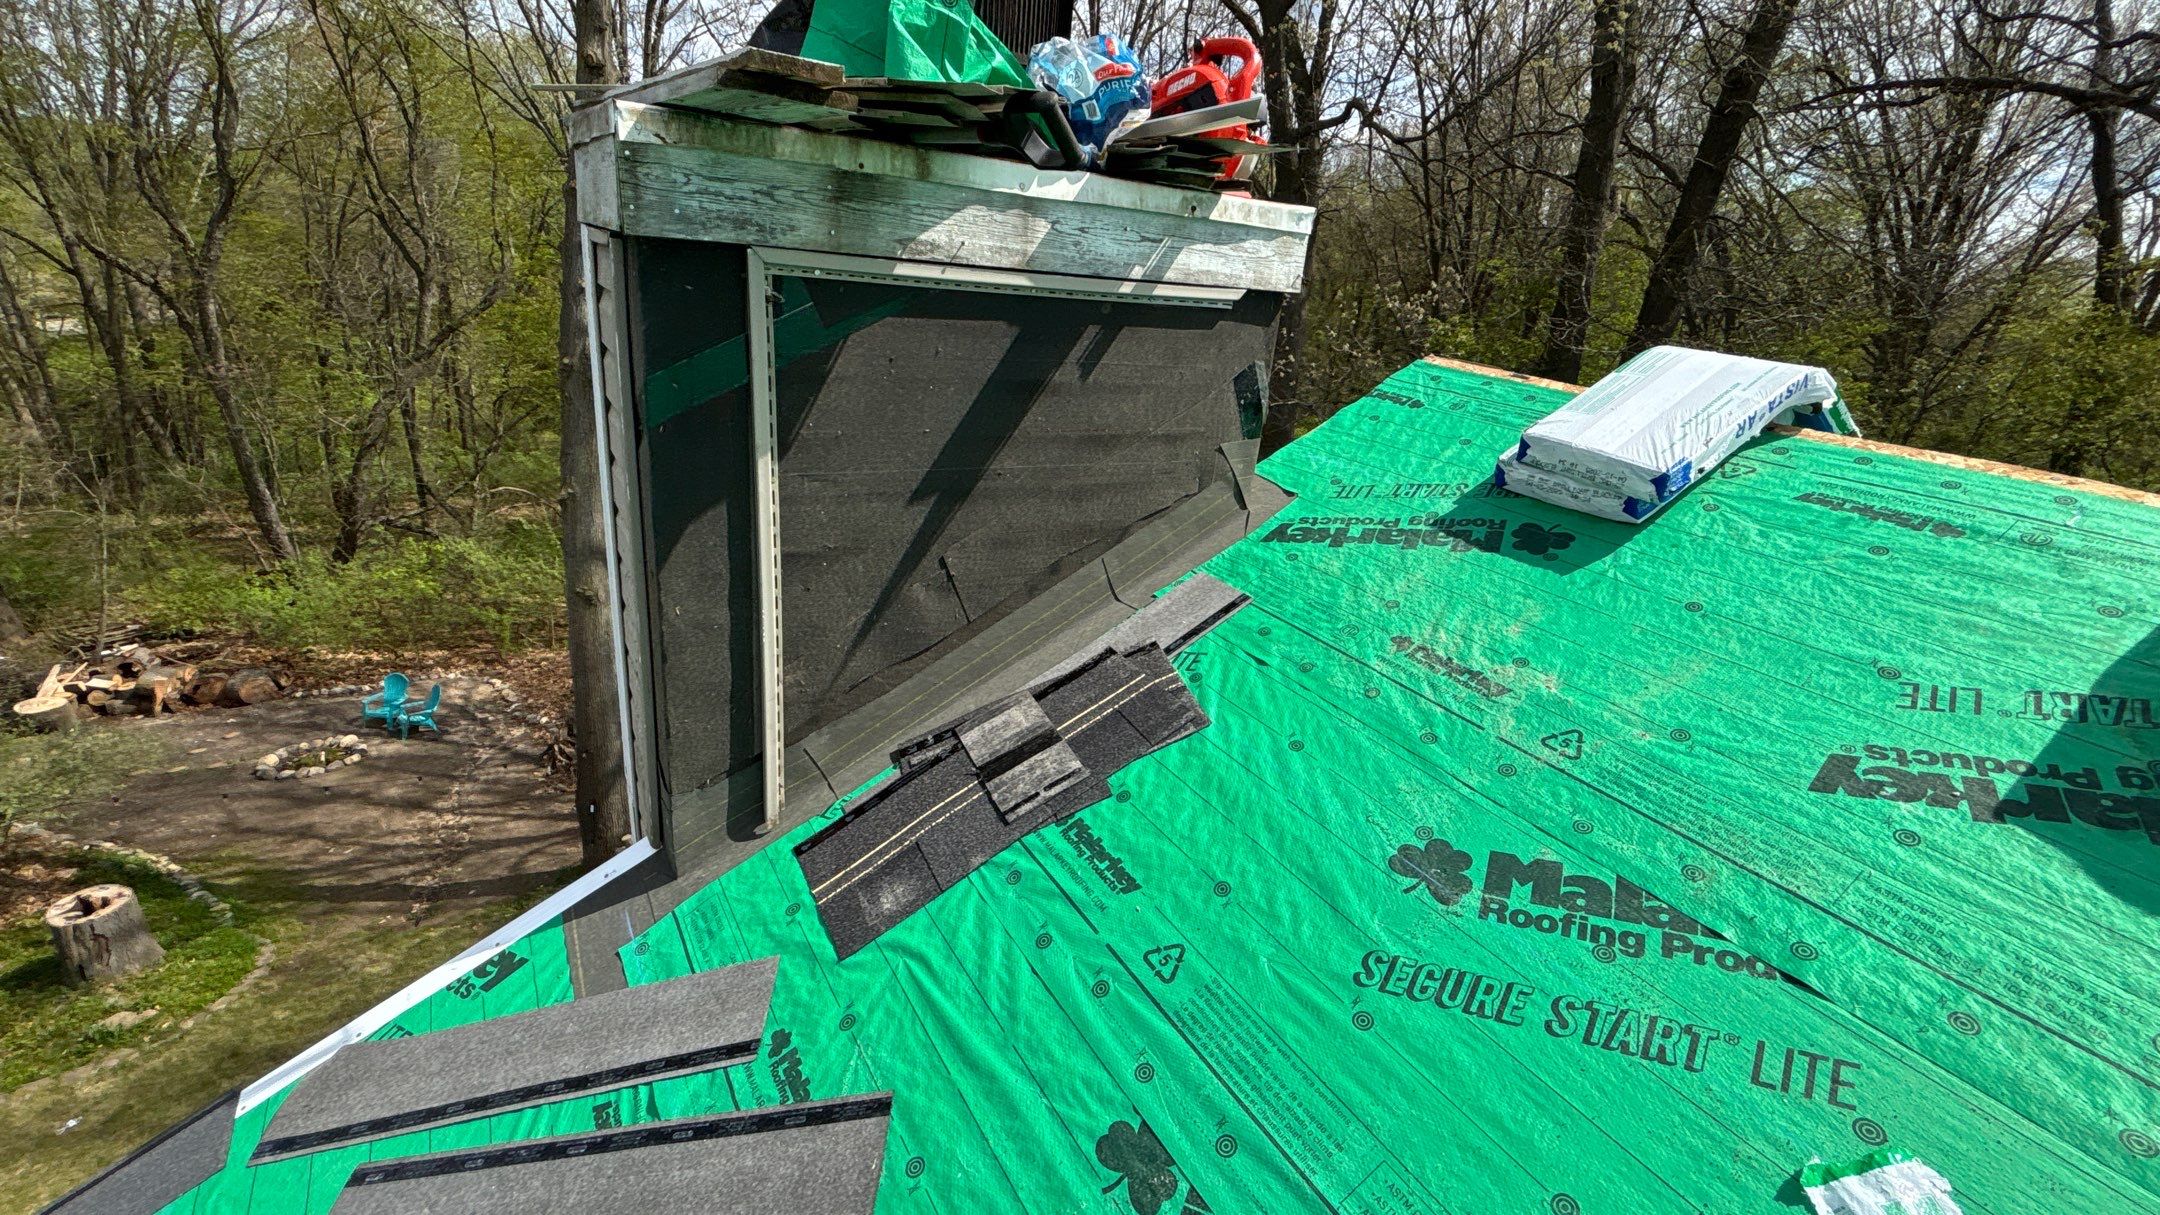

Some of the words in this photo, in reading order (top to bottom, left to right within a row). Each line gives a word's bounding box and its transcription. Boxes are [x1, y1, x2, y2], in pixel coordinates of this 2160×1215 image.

[1768, 373, 1808, 413] VISTA
[1333, 484, 1375, 499] LITE
[1298, 515, 1402, 528] Products
[1407, 517, 1508, 530] Roofing
[1259, 523, 1507, 552] Malarkey
[1895, 681, 1984, 715] LITE
[1059, 828, 1086, 860] Roofing
[1067, 817, 1142, 895] Malarkey
[1478, 897, 1646, 958] Roofing
[1353, 949, 1536, 1027] SECURE
[1750, 1039, 1864, 1112] LITE
[1289, 1059, 1316, 1088] surface
[1387, 1182, 1413, 1209] ASTM
